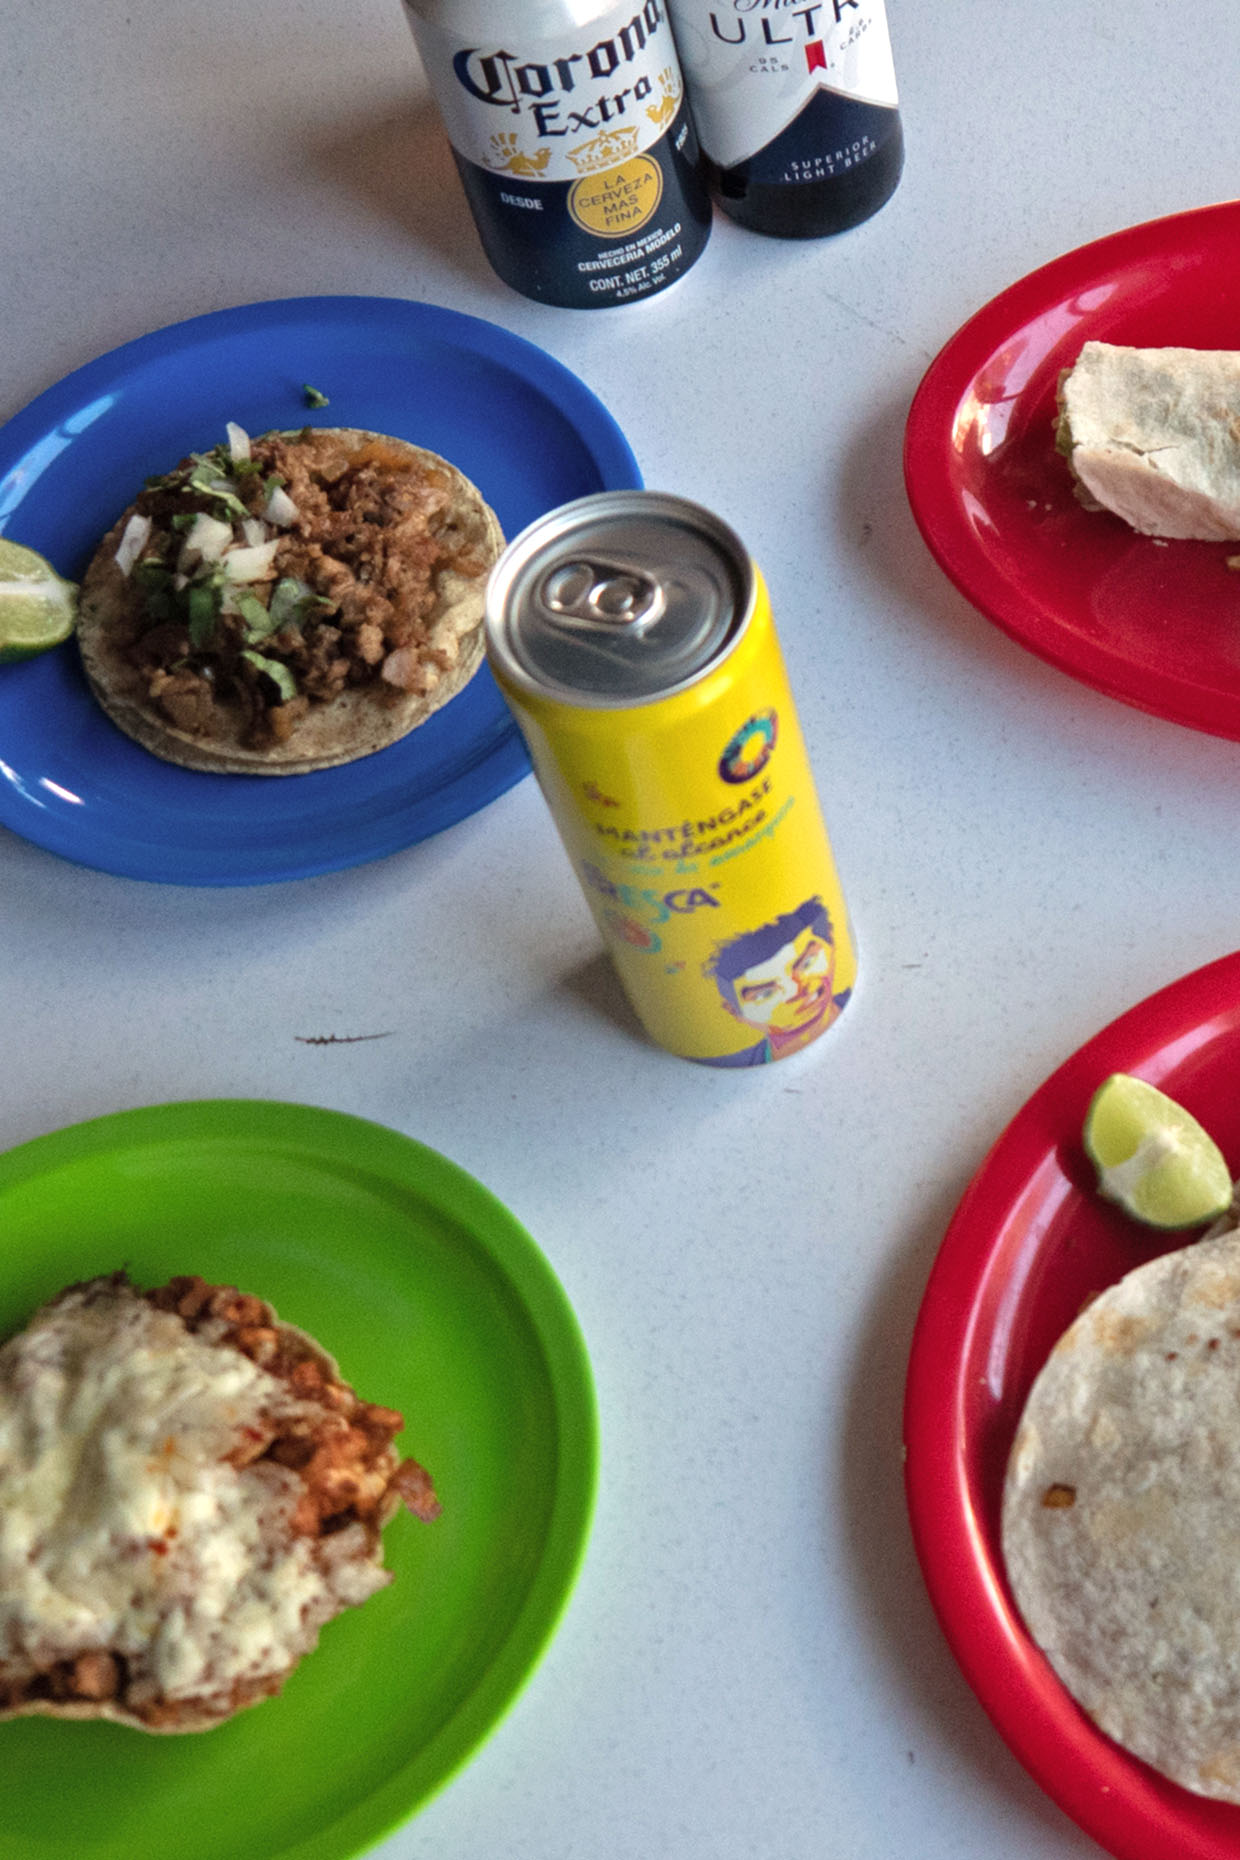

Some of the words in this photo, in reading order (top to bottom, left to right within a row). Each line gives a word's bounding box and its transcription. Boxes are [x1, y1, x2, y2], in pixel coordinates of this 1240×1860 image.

[452, 0, 663, 114] Corona
[529, 75, 652, 138] Extra
[784, 164, 835, 182] LIGHT
[844, 140, 876, 168] BEER
[791, 135, 869, 171] SUPERIOR
[578, 172, 653, 208] CERVEZA
[603, 174, 626, 190] LA
[500, 191, 544, 210] DESDE
[603, 194, 639, 215] MAS
[605, 206, 642, 227] FINA
[577, 249, 645, 272] CERVECERIA
[645, 222, 682, 254] MODELO
[625, 243, 637, 252] EN
[589, 276, 625, 292] CONT.
[625, 266, 651, 285] NET.
[650, 254, 671, 274] 355
[670, 244, 683, 262] ml
